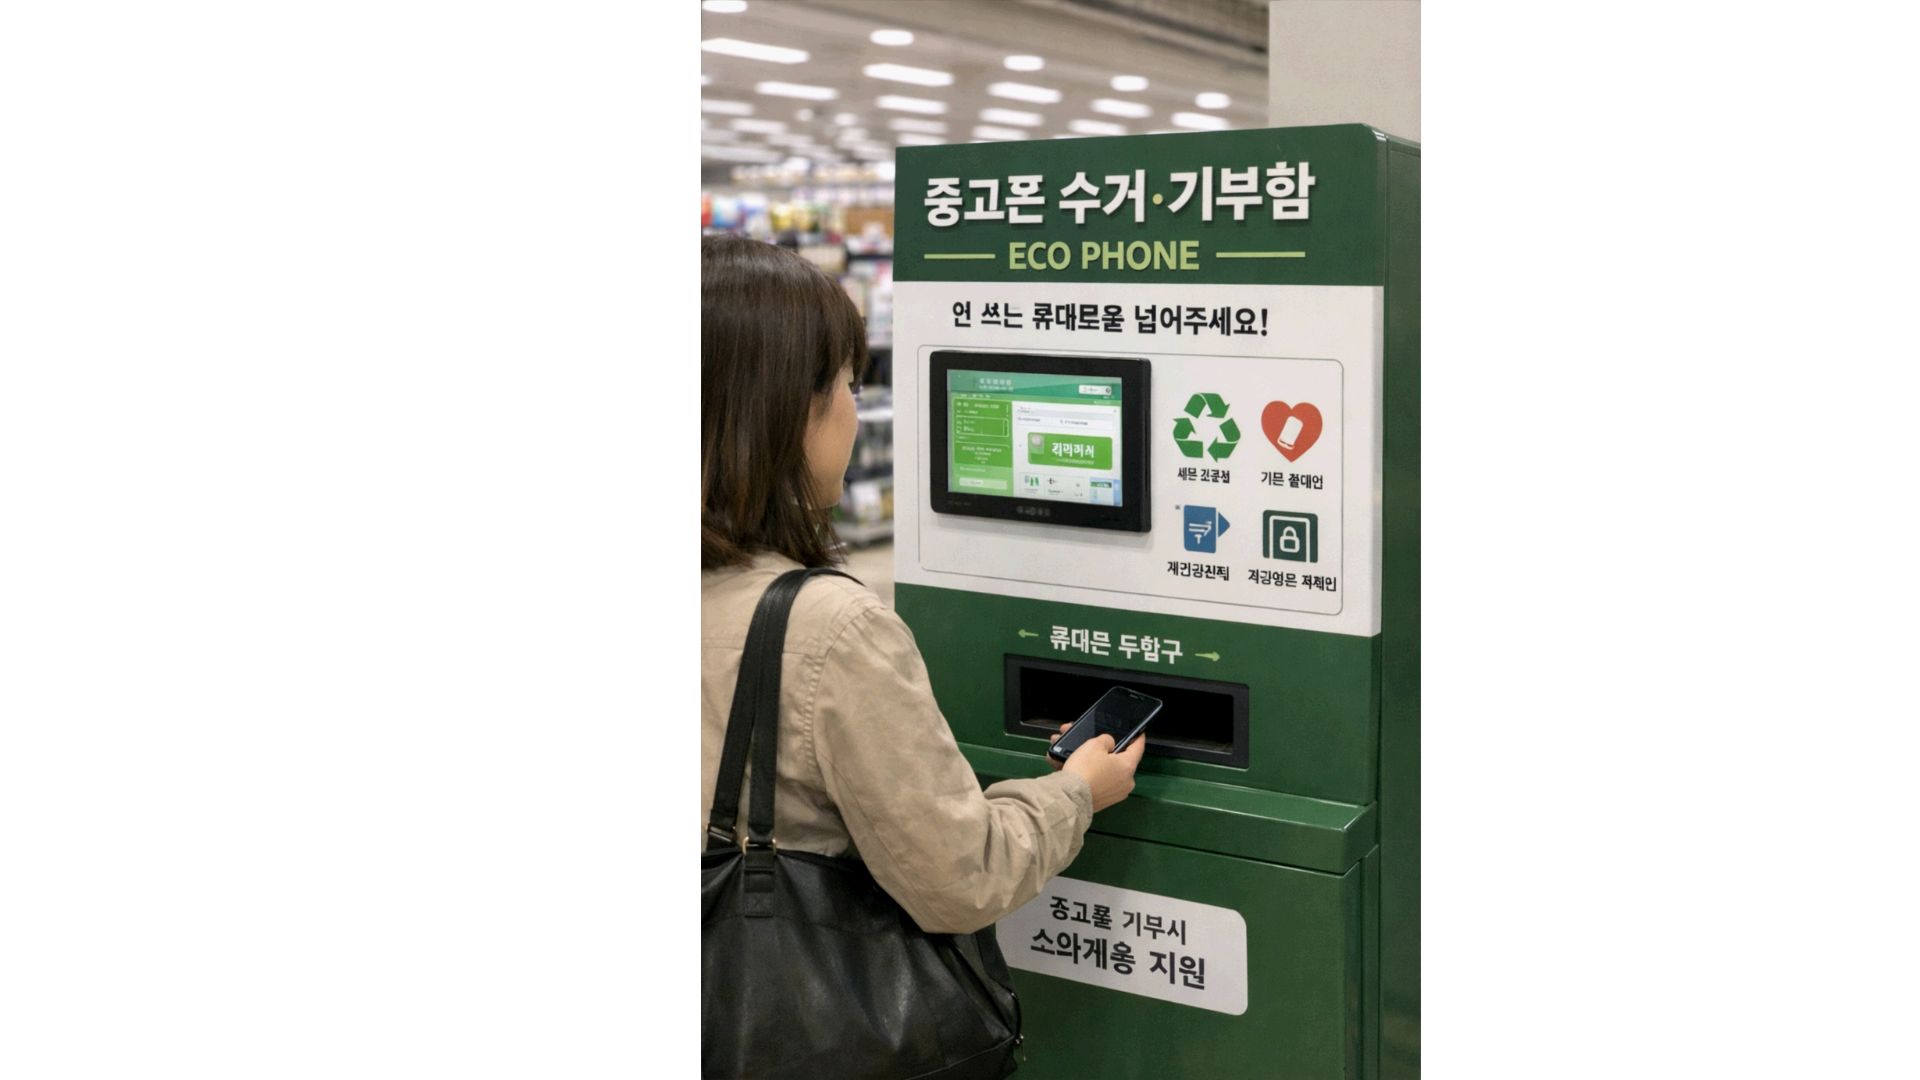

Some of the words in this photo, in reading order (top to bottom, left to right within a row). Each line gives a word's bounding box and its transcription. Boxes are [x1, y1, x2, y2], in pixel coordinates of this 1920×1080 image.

[1009, 241, 1072, 271] ECO
[1081, 240, 1200, 271] PHONE
[1149, 951, 1206, 990] 지원
